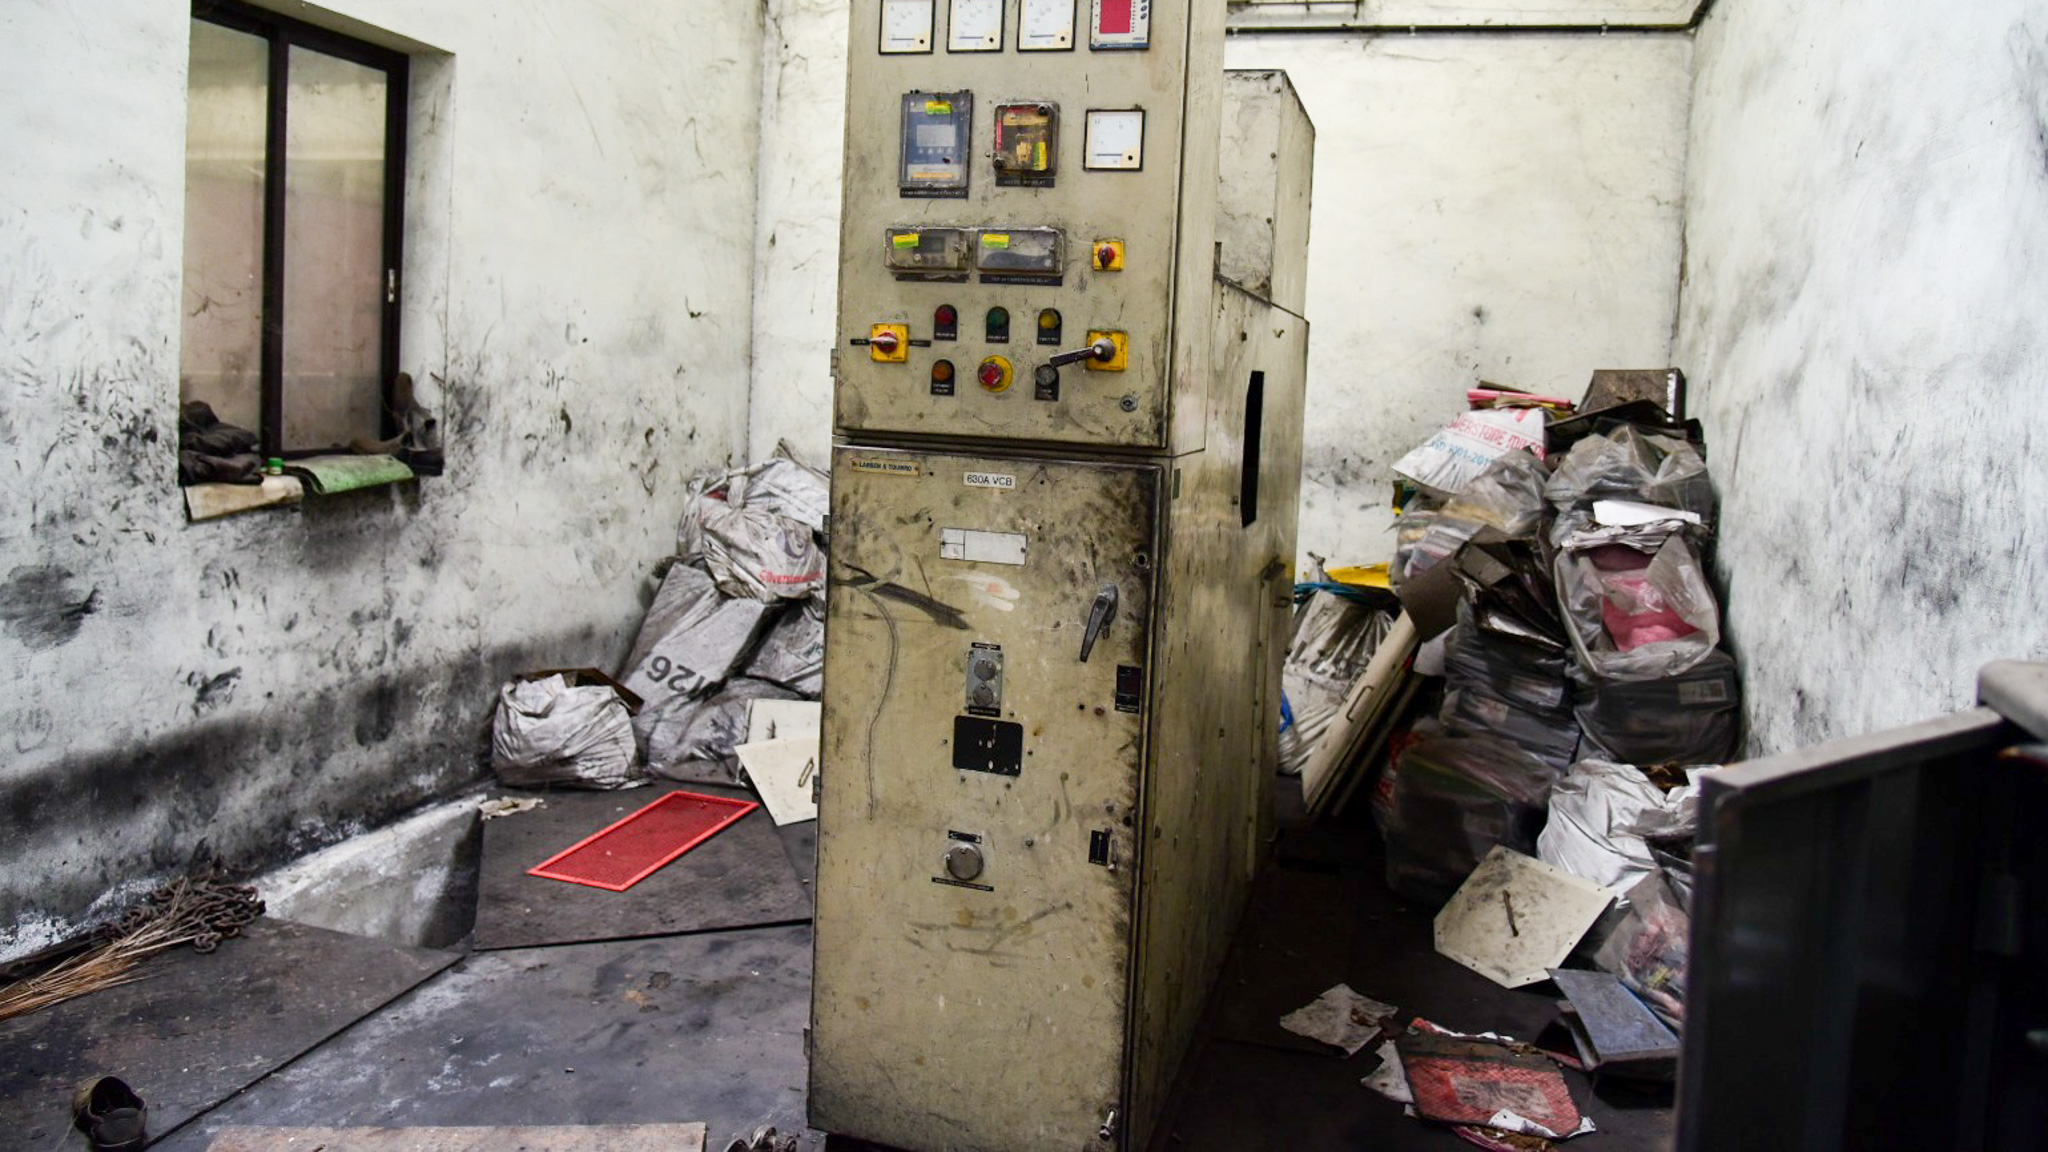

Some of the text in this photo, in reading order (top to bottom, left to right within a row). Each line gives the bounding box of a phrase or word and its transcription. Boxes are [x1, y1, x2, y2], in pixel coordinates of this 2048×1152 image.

[967, 474, 1012, 487] 630A VCB
[646, 655, 705, 699] 126
